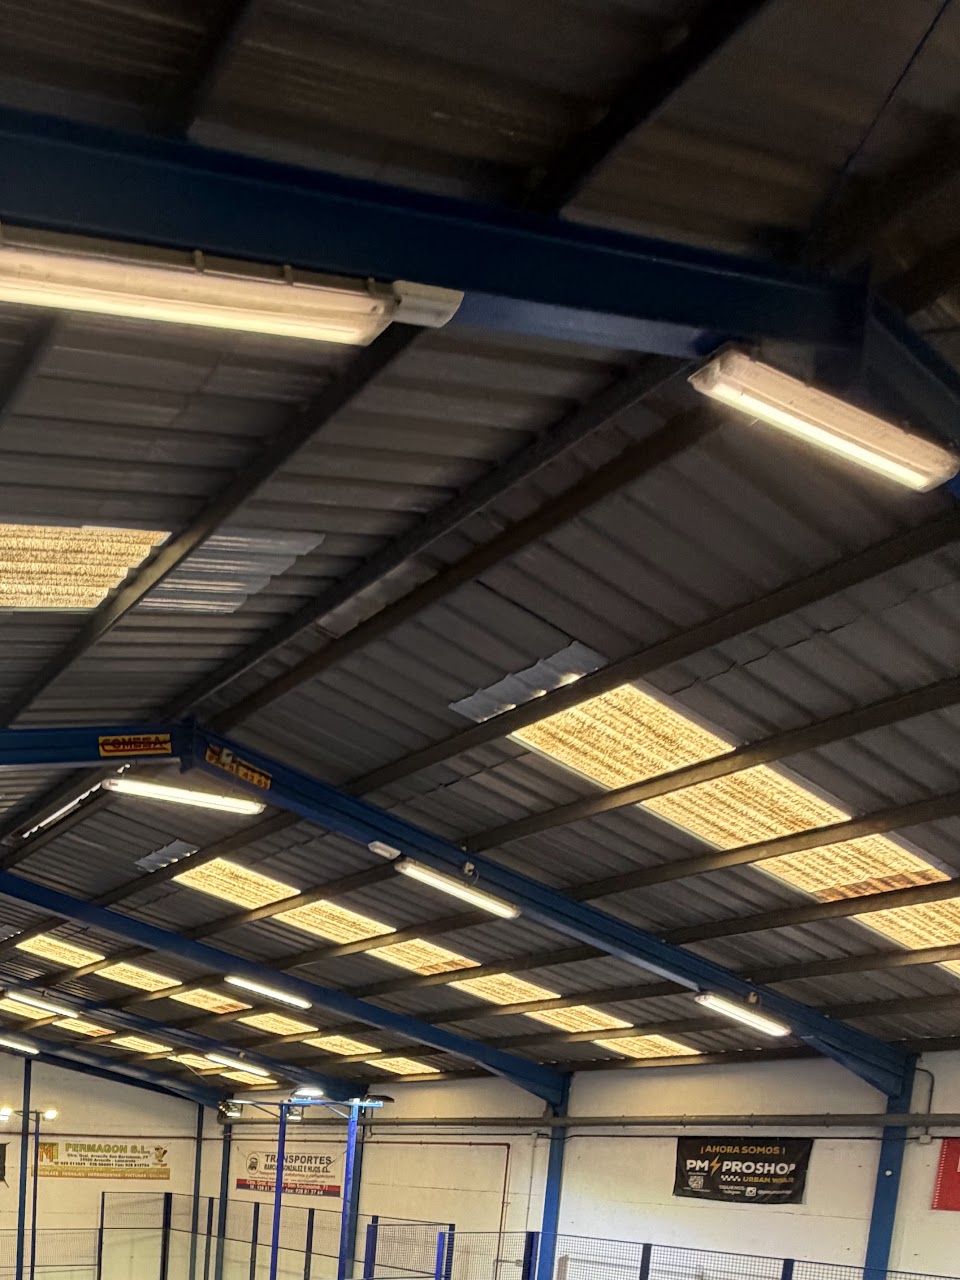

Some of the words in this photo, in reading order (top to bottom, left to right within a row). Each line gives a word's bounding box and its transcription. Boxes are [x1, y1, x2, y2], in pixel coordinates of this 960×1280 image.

[65, 1143, 128, 1154] PERMAGON
[131, 1145, 150, 1155] S.L.
[265, 1154, 331, 1165] TRNSPORTES
[686, 1159, 709, 1171] PM
[722, 1160, 796, 1175] PROSHOP
